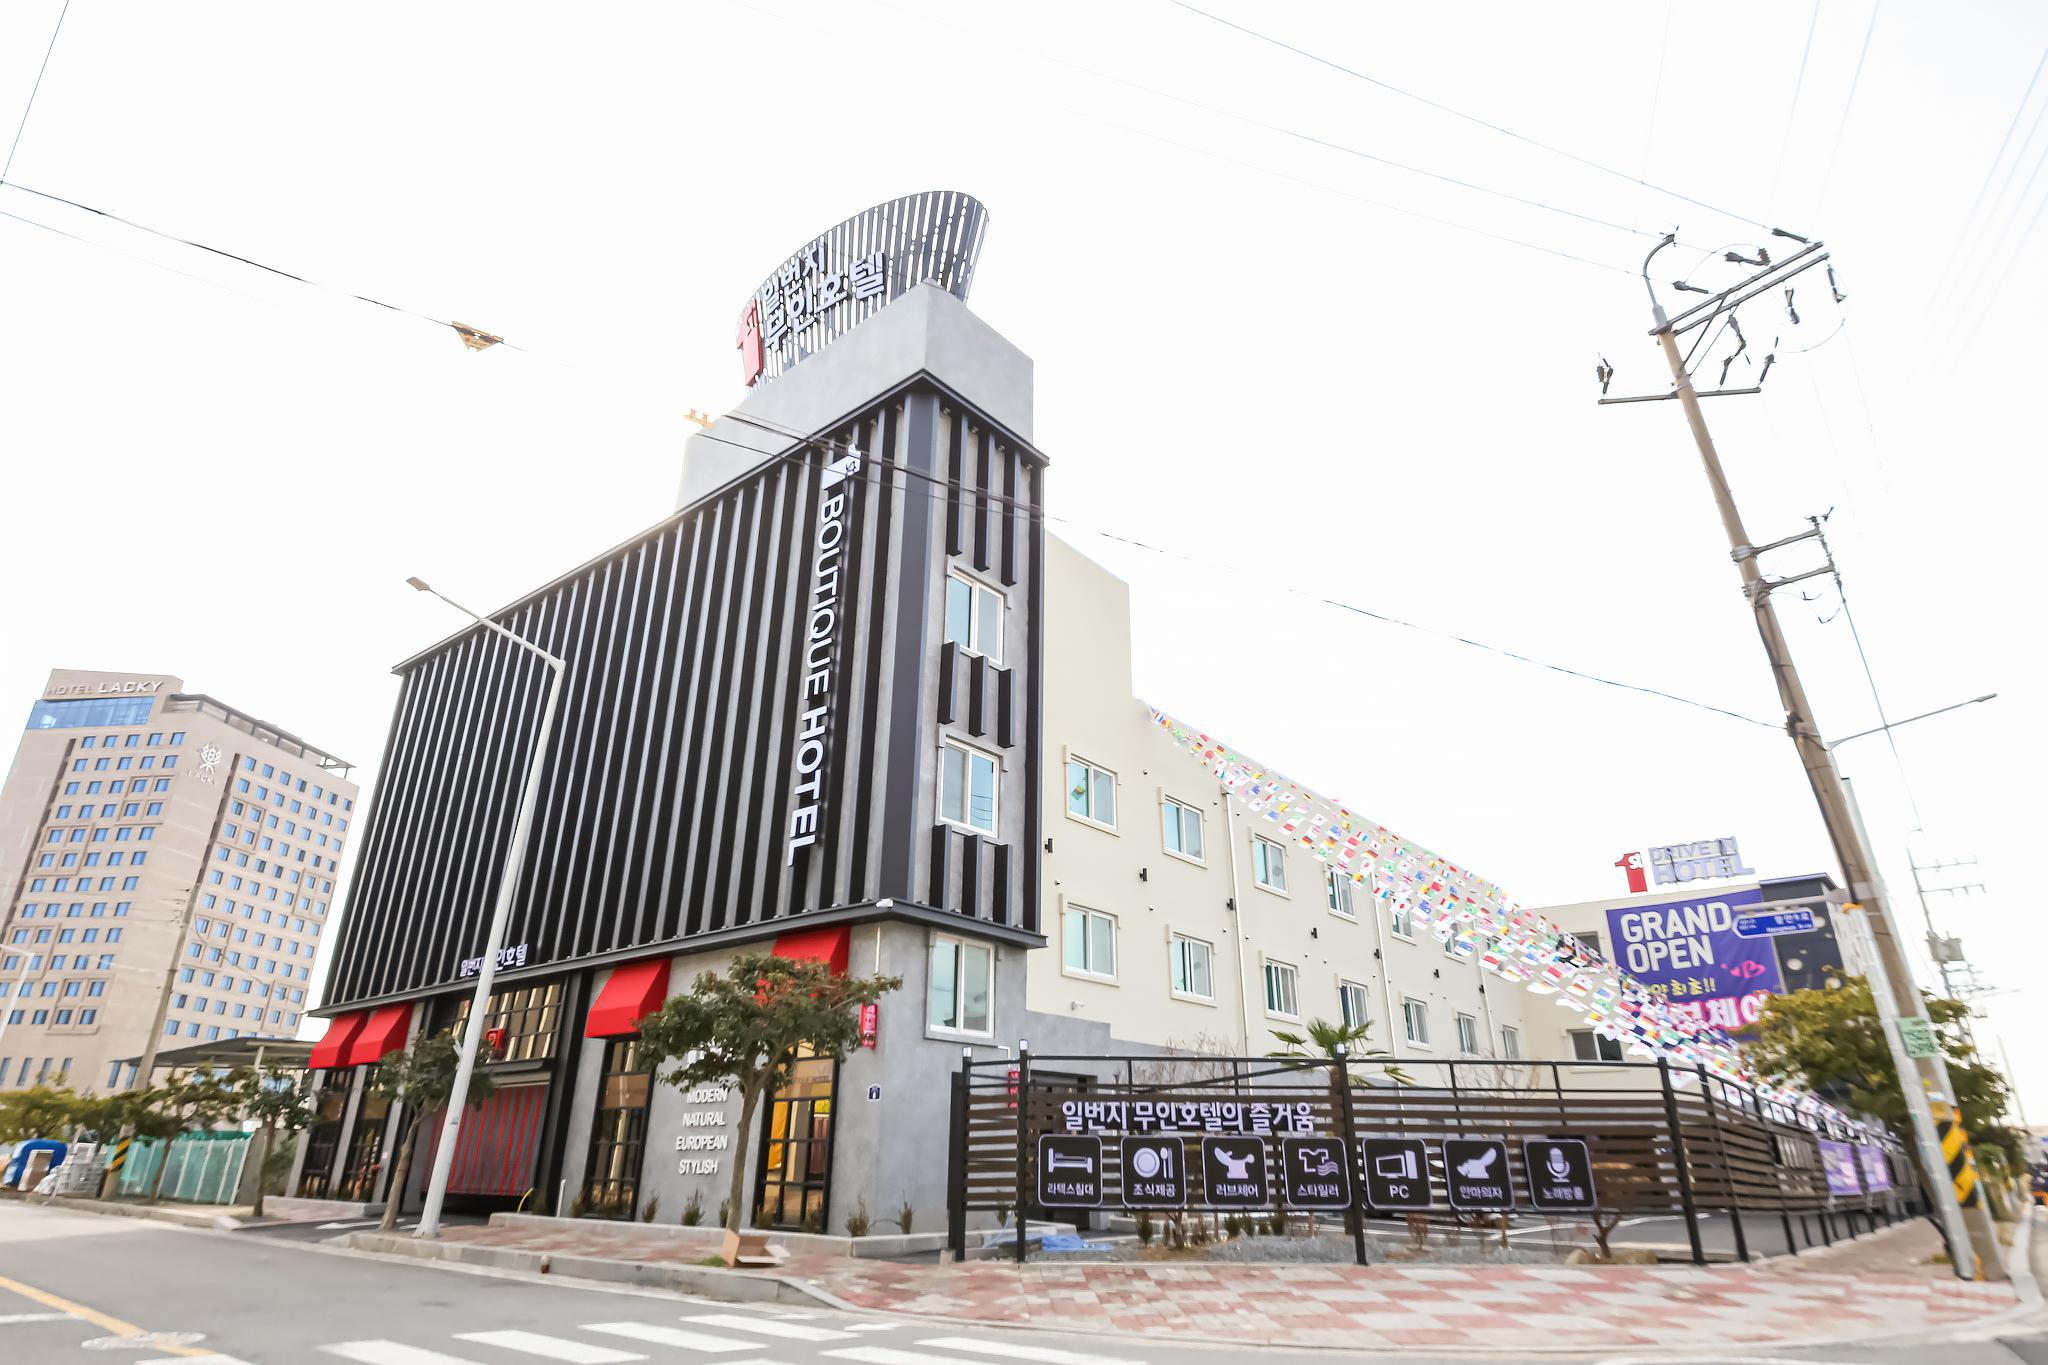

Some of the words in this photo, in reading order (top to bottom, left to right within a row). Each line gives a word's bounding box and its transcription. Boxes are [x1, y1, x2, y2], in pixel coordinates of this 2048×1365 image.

[761, 241, 825, 312] 일번지
[765, 251, 885, 352] 무인호텔
[803, 493, 845, 701] BOUTIQUE
[47, 684, 94, 696] HOTEL
[97, 681, 164, 694] LACKY
[787, 705, 828, 867] HOTEL
[1648, 840, 1715, 861] DRIVE
[1652, 854, 1756, 886] HOTEL
[1620, 901, 1732, 943] GRAND
[1626, 935, 1714, 973] OPEN
[686, 1088, 729, 1104] MODERN
[682, 1111, 727, 1127] NATURAL
[1062, 1100, 1128, 1131] 일번지
[1133, 1101, 1245, 1134] 무인호텔의
[1249, 1102, 1315, 1133] 즐거움
[675, 1135, 729, 1152] EUROPEAN
[679, 1159, 720, 1175] STYLISH
[1132, 1183, 1177, 1198] 조식제공
[1297, 1183, 1339, 1198] 스타일러
[1389, 1184, 1410, 1199] PC
[1459, 1185, 1504, 1200] 안마의자
